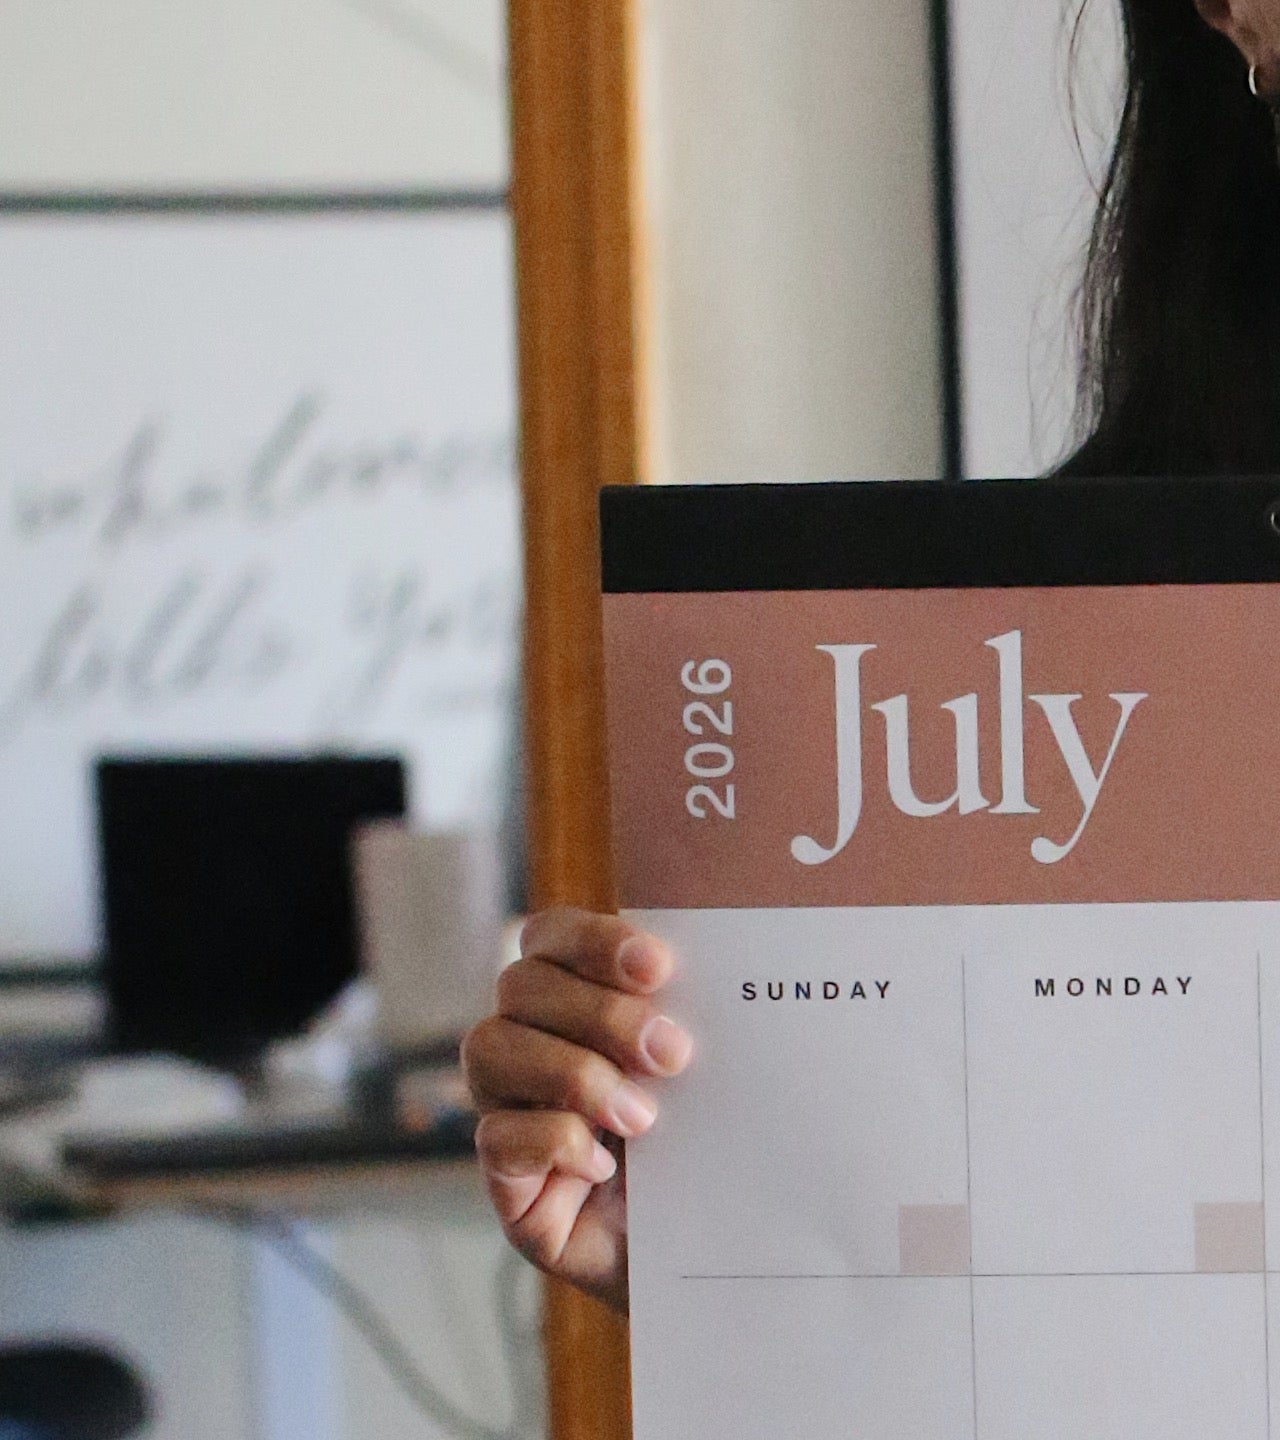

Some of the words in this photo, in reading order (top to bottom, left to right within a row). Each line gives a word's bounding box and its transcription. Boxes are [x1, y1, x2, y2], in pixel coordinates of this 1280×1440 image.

[680, 658, 736, 819] 2026
[790, 628, 1149, 866] July
[741, 980, 890, 1002] SUNDAY
[1034, 976, 1192, 997] MONDAY
